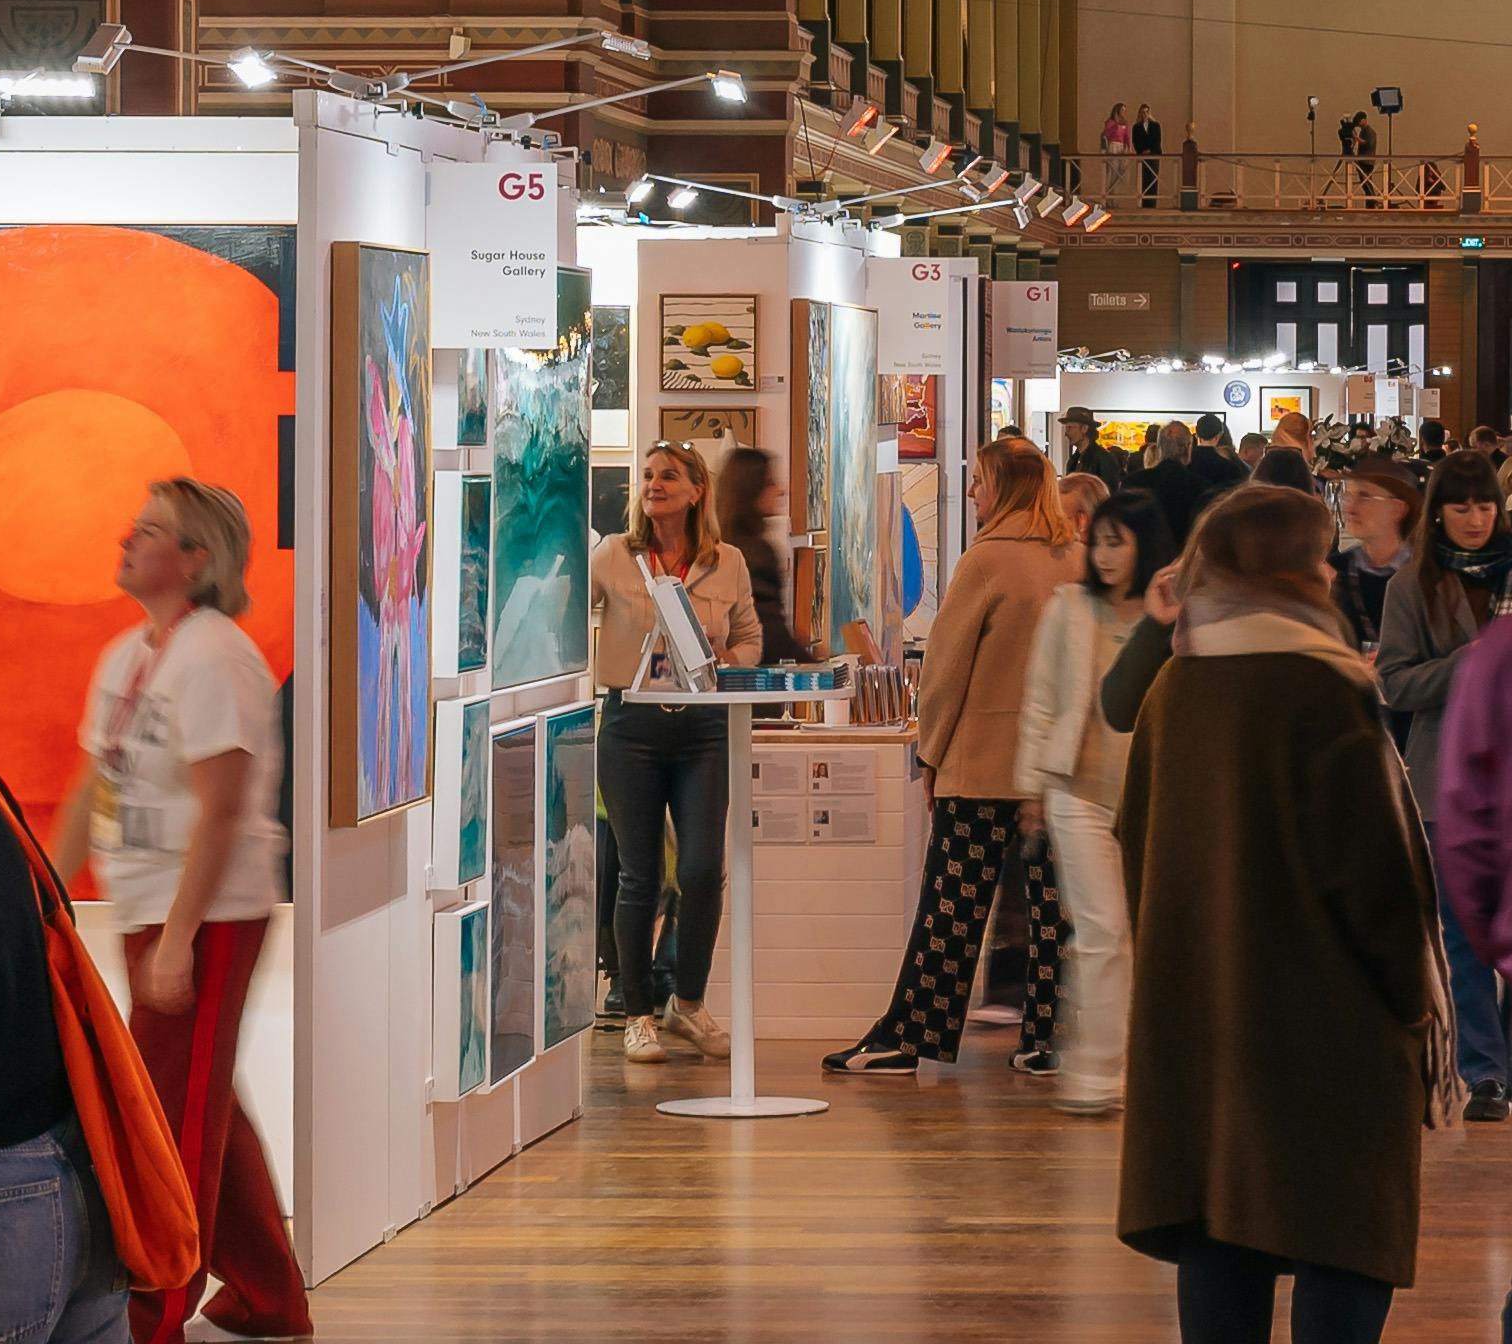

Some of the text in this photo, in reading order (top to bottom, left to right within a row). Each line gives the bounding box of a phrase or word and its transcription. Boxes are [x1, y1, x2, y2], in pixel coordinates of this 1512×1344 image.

[498, 172, 545, 200] G5
[471, 250, 545, 263] Sugar House
[502, 265, 546, 278] Gallery
[912, 264, 941, 280] G3
[1026, 287, 1050, 301] G1
[1090, 293, 1127, 306] Toilets
[515, 315, 546, 326] Sydney
[471, 329, 545, 338] New South Wales
